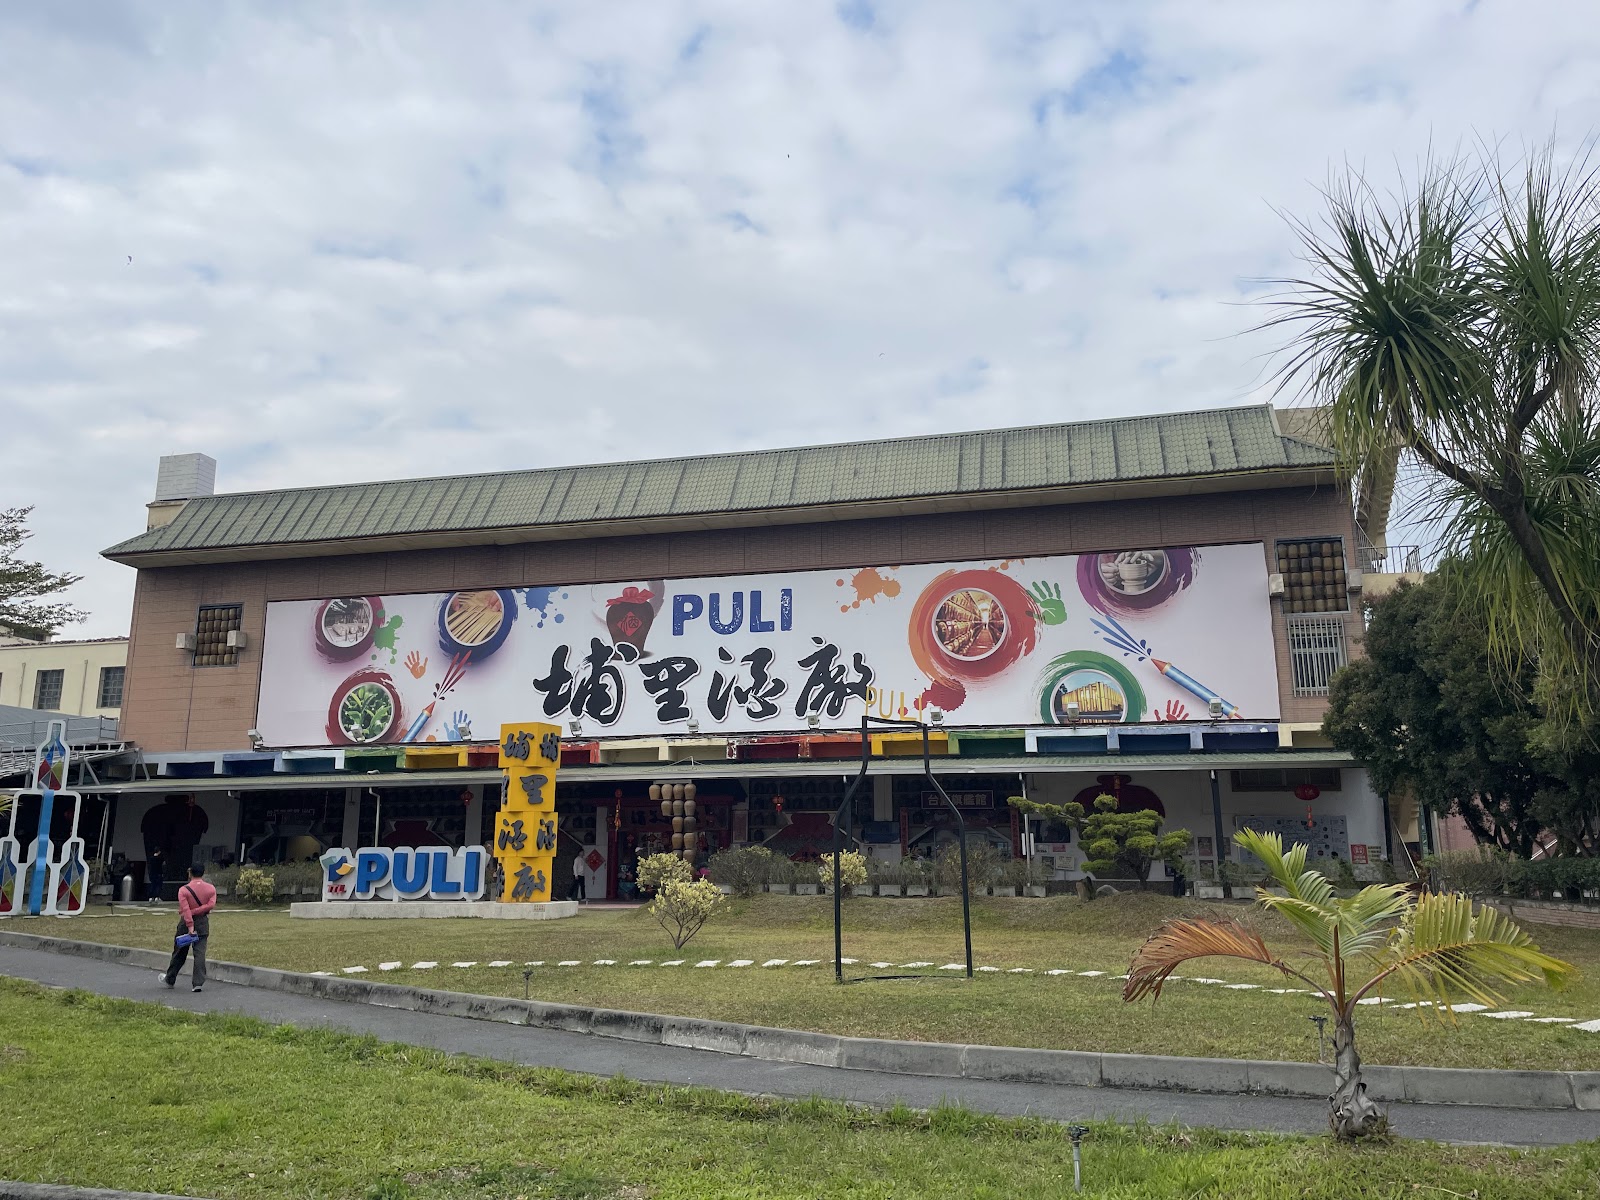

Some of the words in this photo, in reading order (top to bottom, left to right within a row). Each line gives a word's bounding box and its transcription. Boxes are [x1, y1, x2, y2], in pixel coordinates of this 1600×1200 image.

[672, 588, 793, 636] PULI
[532, 636, 876, 724] 埔里酒廠
[865, 686, 923, 722] PULI
[356, 852, 480, 893] PULI
